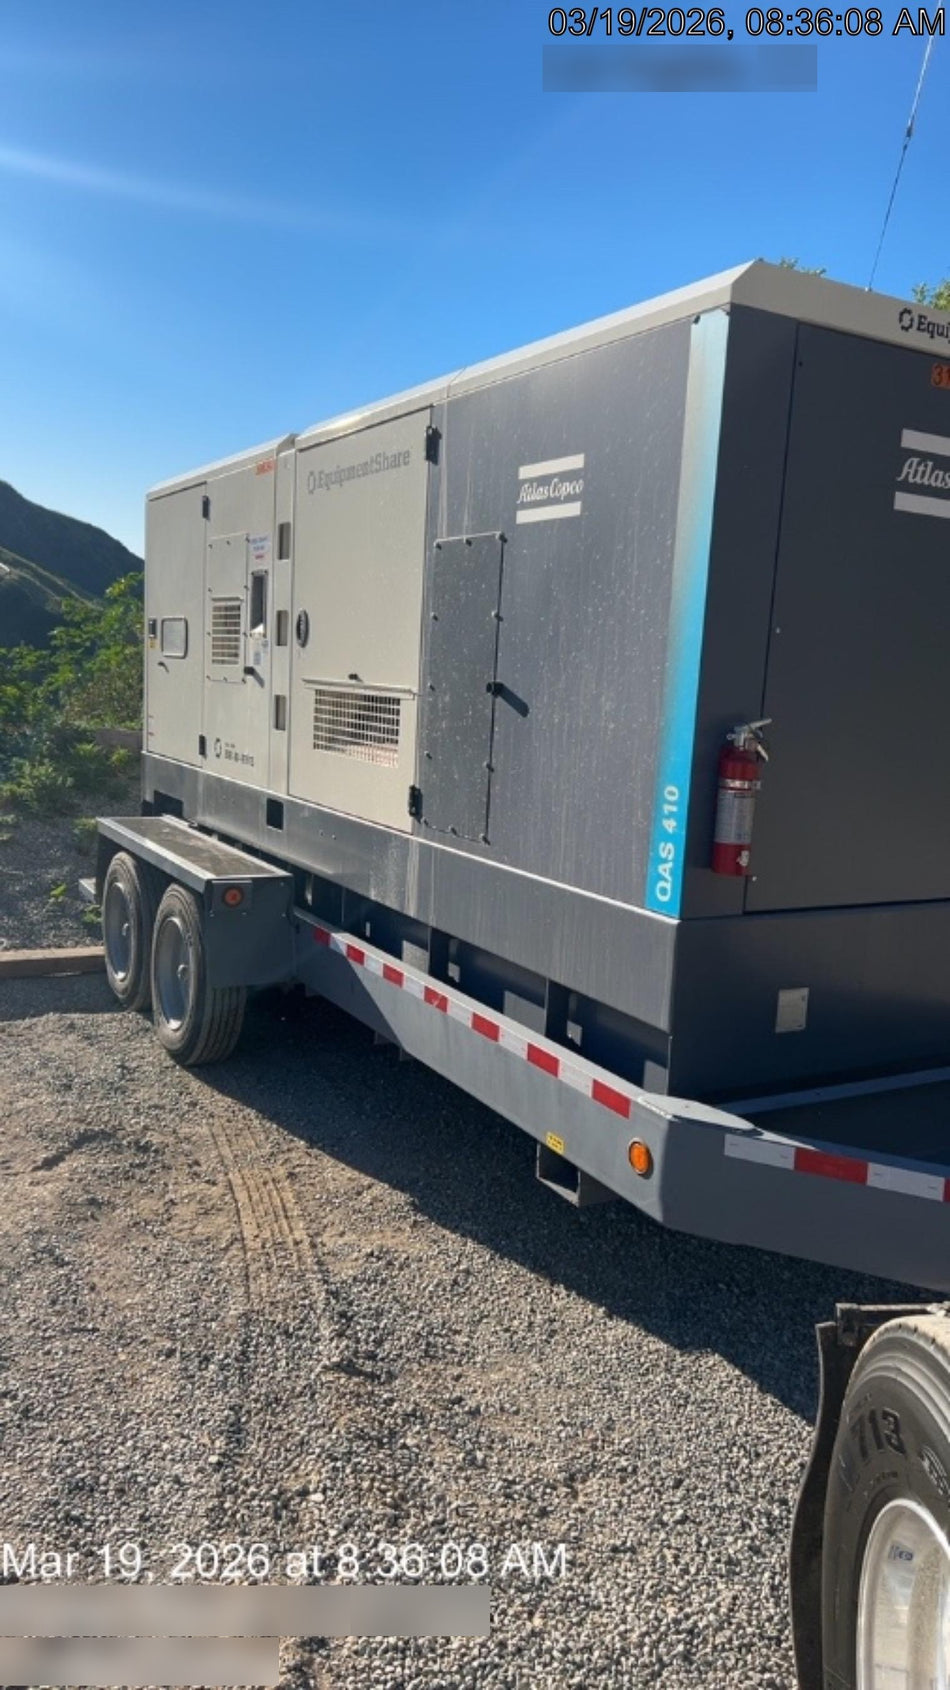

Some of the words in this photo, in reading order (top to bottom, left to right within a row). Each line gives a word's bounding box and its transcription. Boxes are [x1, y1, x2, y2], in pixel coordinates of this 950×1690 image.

[317, 450, 410, 490] EquipmentShare
[662, 785, 680, 834] 410
[656, 842, 675, 902] QAS
